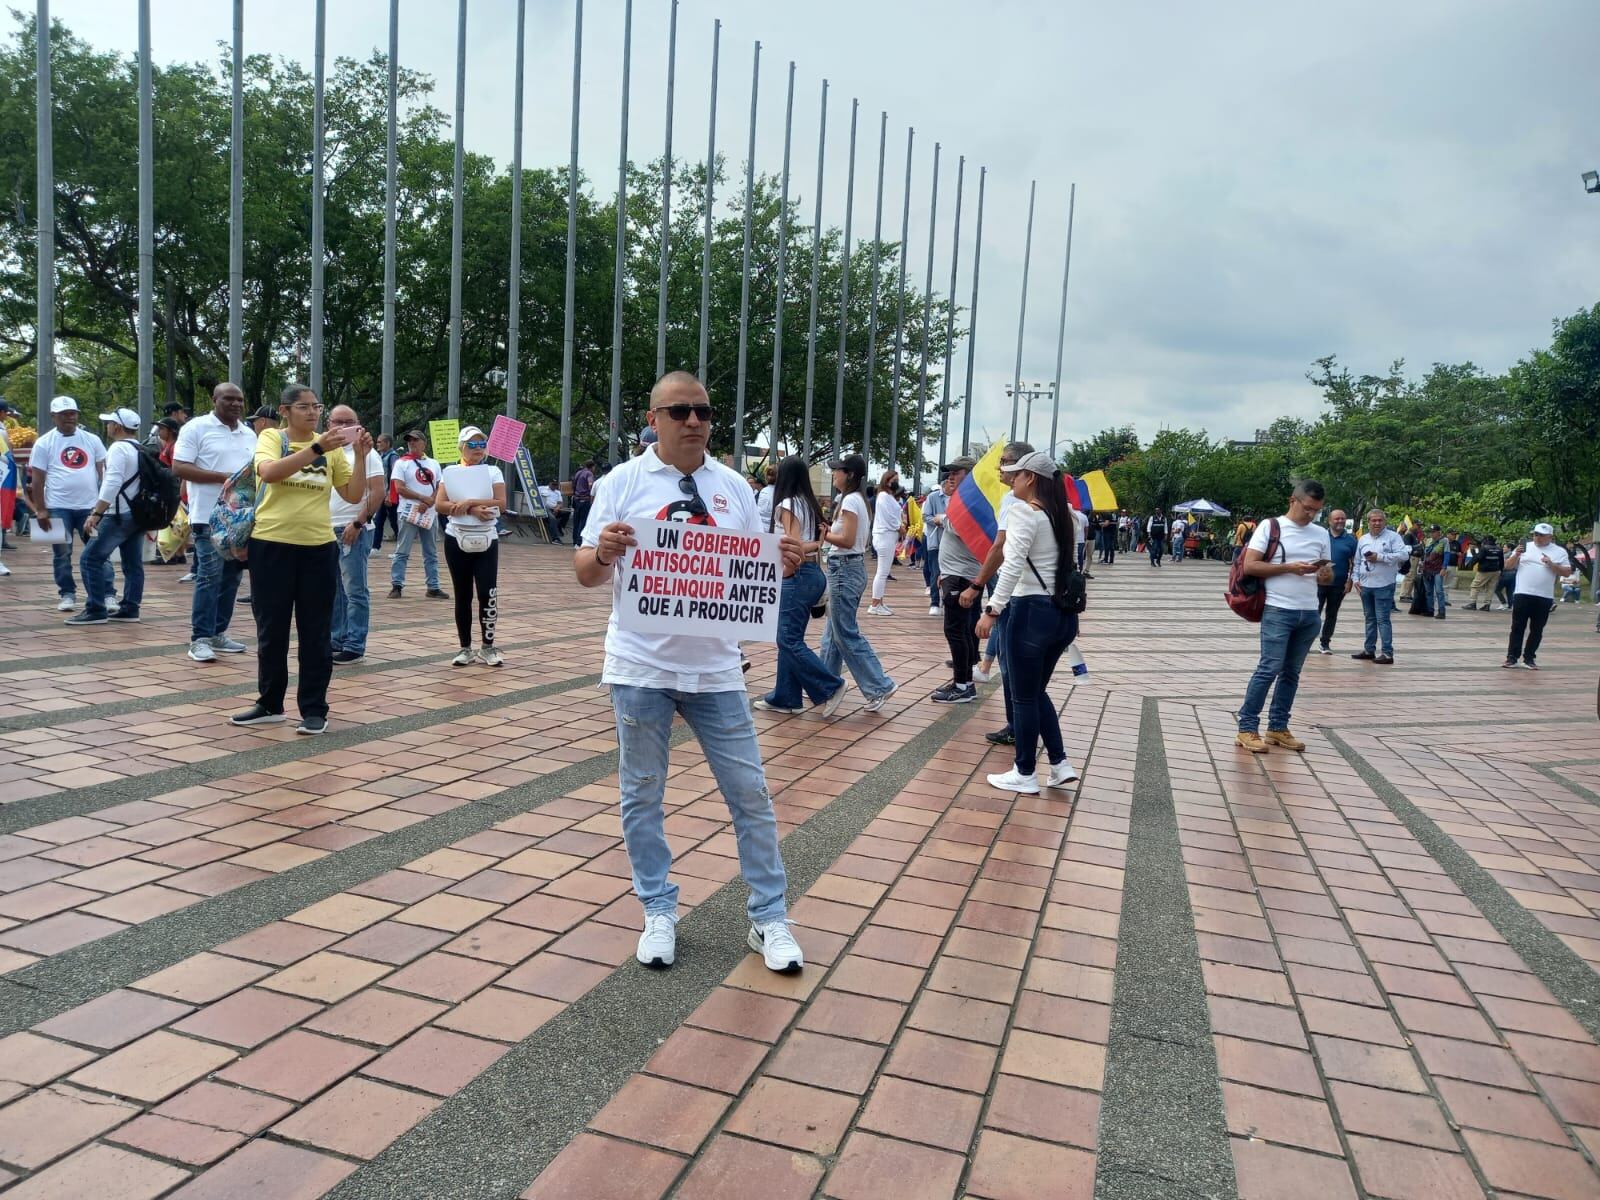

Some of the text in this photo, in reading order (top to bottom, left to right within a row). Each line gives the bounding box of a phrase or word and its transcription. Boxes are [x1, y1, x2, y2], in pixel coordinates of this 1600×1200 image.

[517, 449, 541, 508] FERPOL
[657, 527, 761, 558] UN GOBIERNO
[631, 549, 777, 583] ANTISOCIAL INCITA
[628, 574, 777, 605] A DELINQUIR ANTES
[481, 587, 497, 641] adidas
[638, 596, 764, 624] QUE A PRODUCIR
